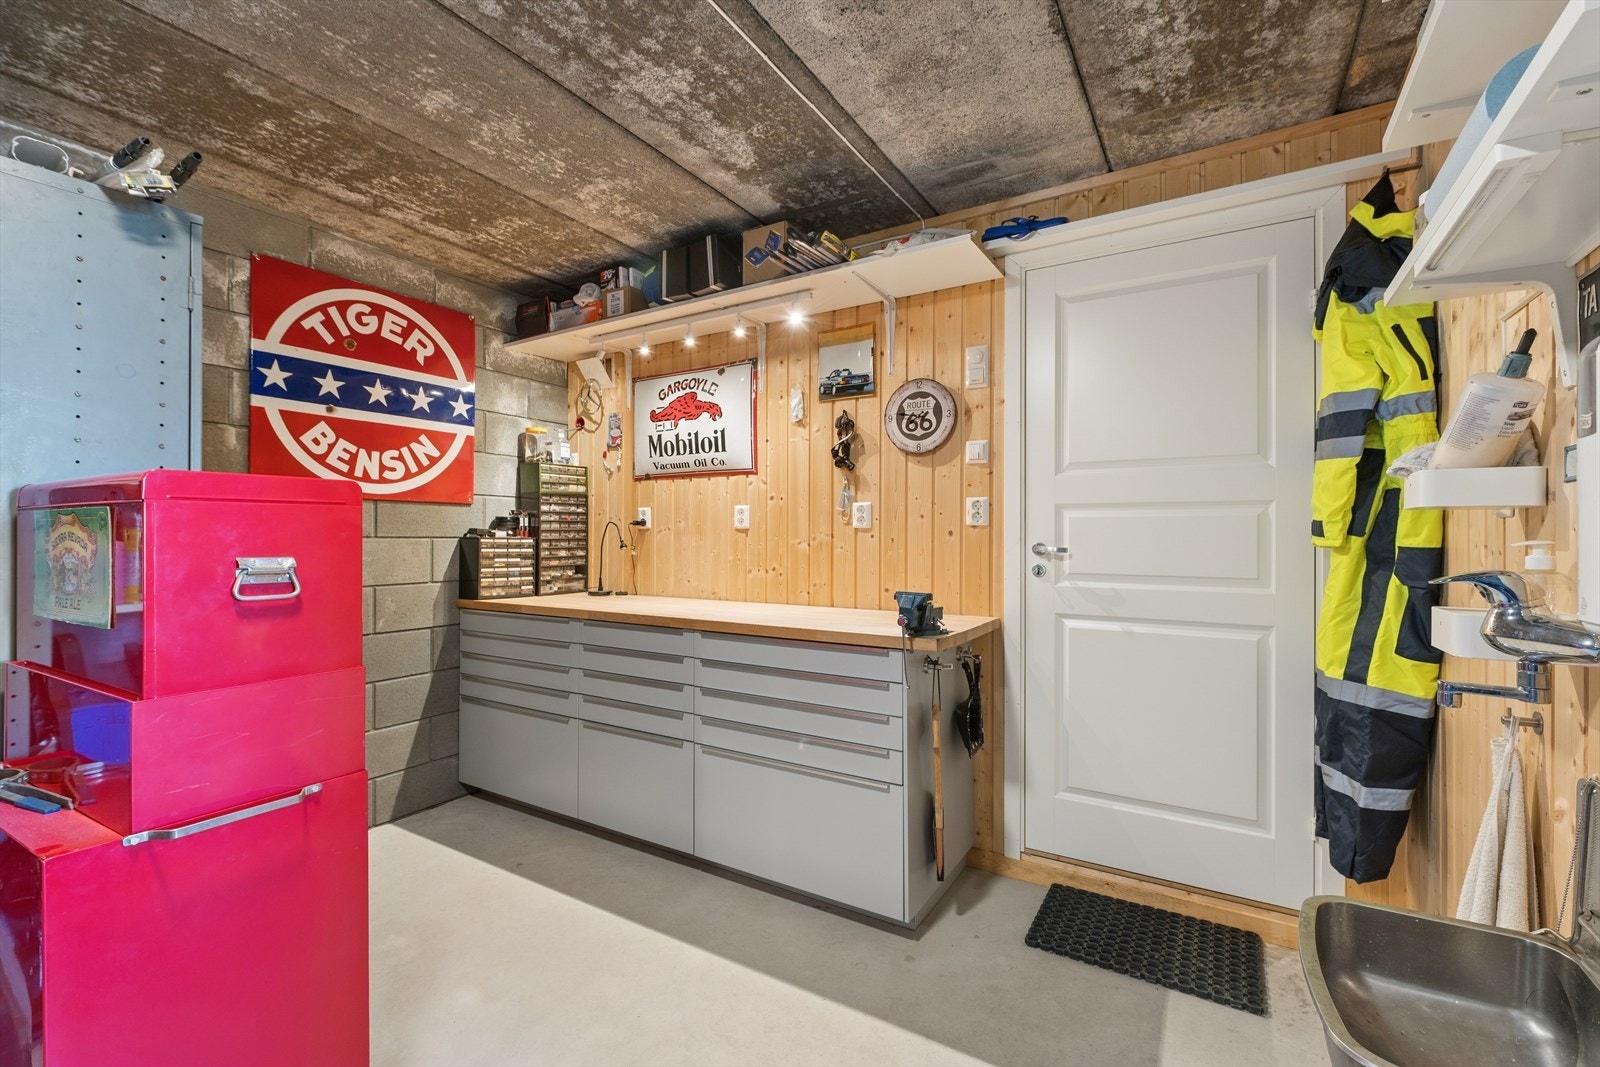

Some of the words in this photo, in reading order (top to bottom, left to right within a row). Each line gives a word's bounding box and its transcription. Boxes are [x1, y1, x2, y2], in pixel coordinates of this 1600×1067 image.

[300, 303, 435, 367] TIGER
[658, 377, 719, 401] GARGOYLE
[916, 380, 923, 388] 12
[906, 400, 931, 409] ROUTE
[905, 410, 933, 432] 66
[946, 410, 952, 418] 3
[299, 420, 441, 481] BENSIN
[647, 427, 727, 459] Mobiloil
[916, 443, 921, 451] 6
[652, 460, 691, 471] Vacuum
[693, 458, 708, 468] Oil
[710, 457, 727, 467] Co.
